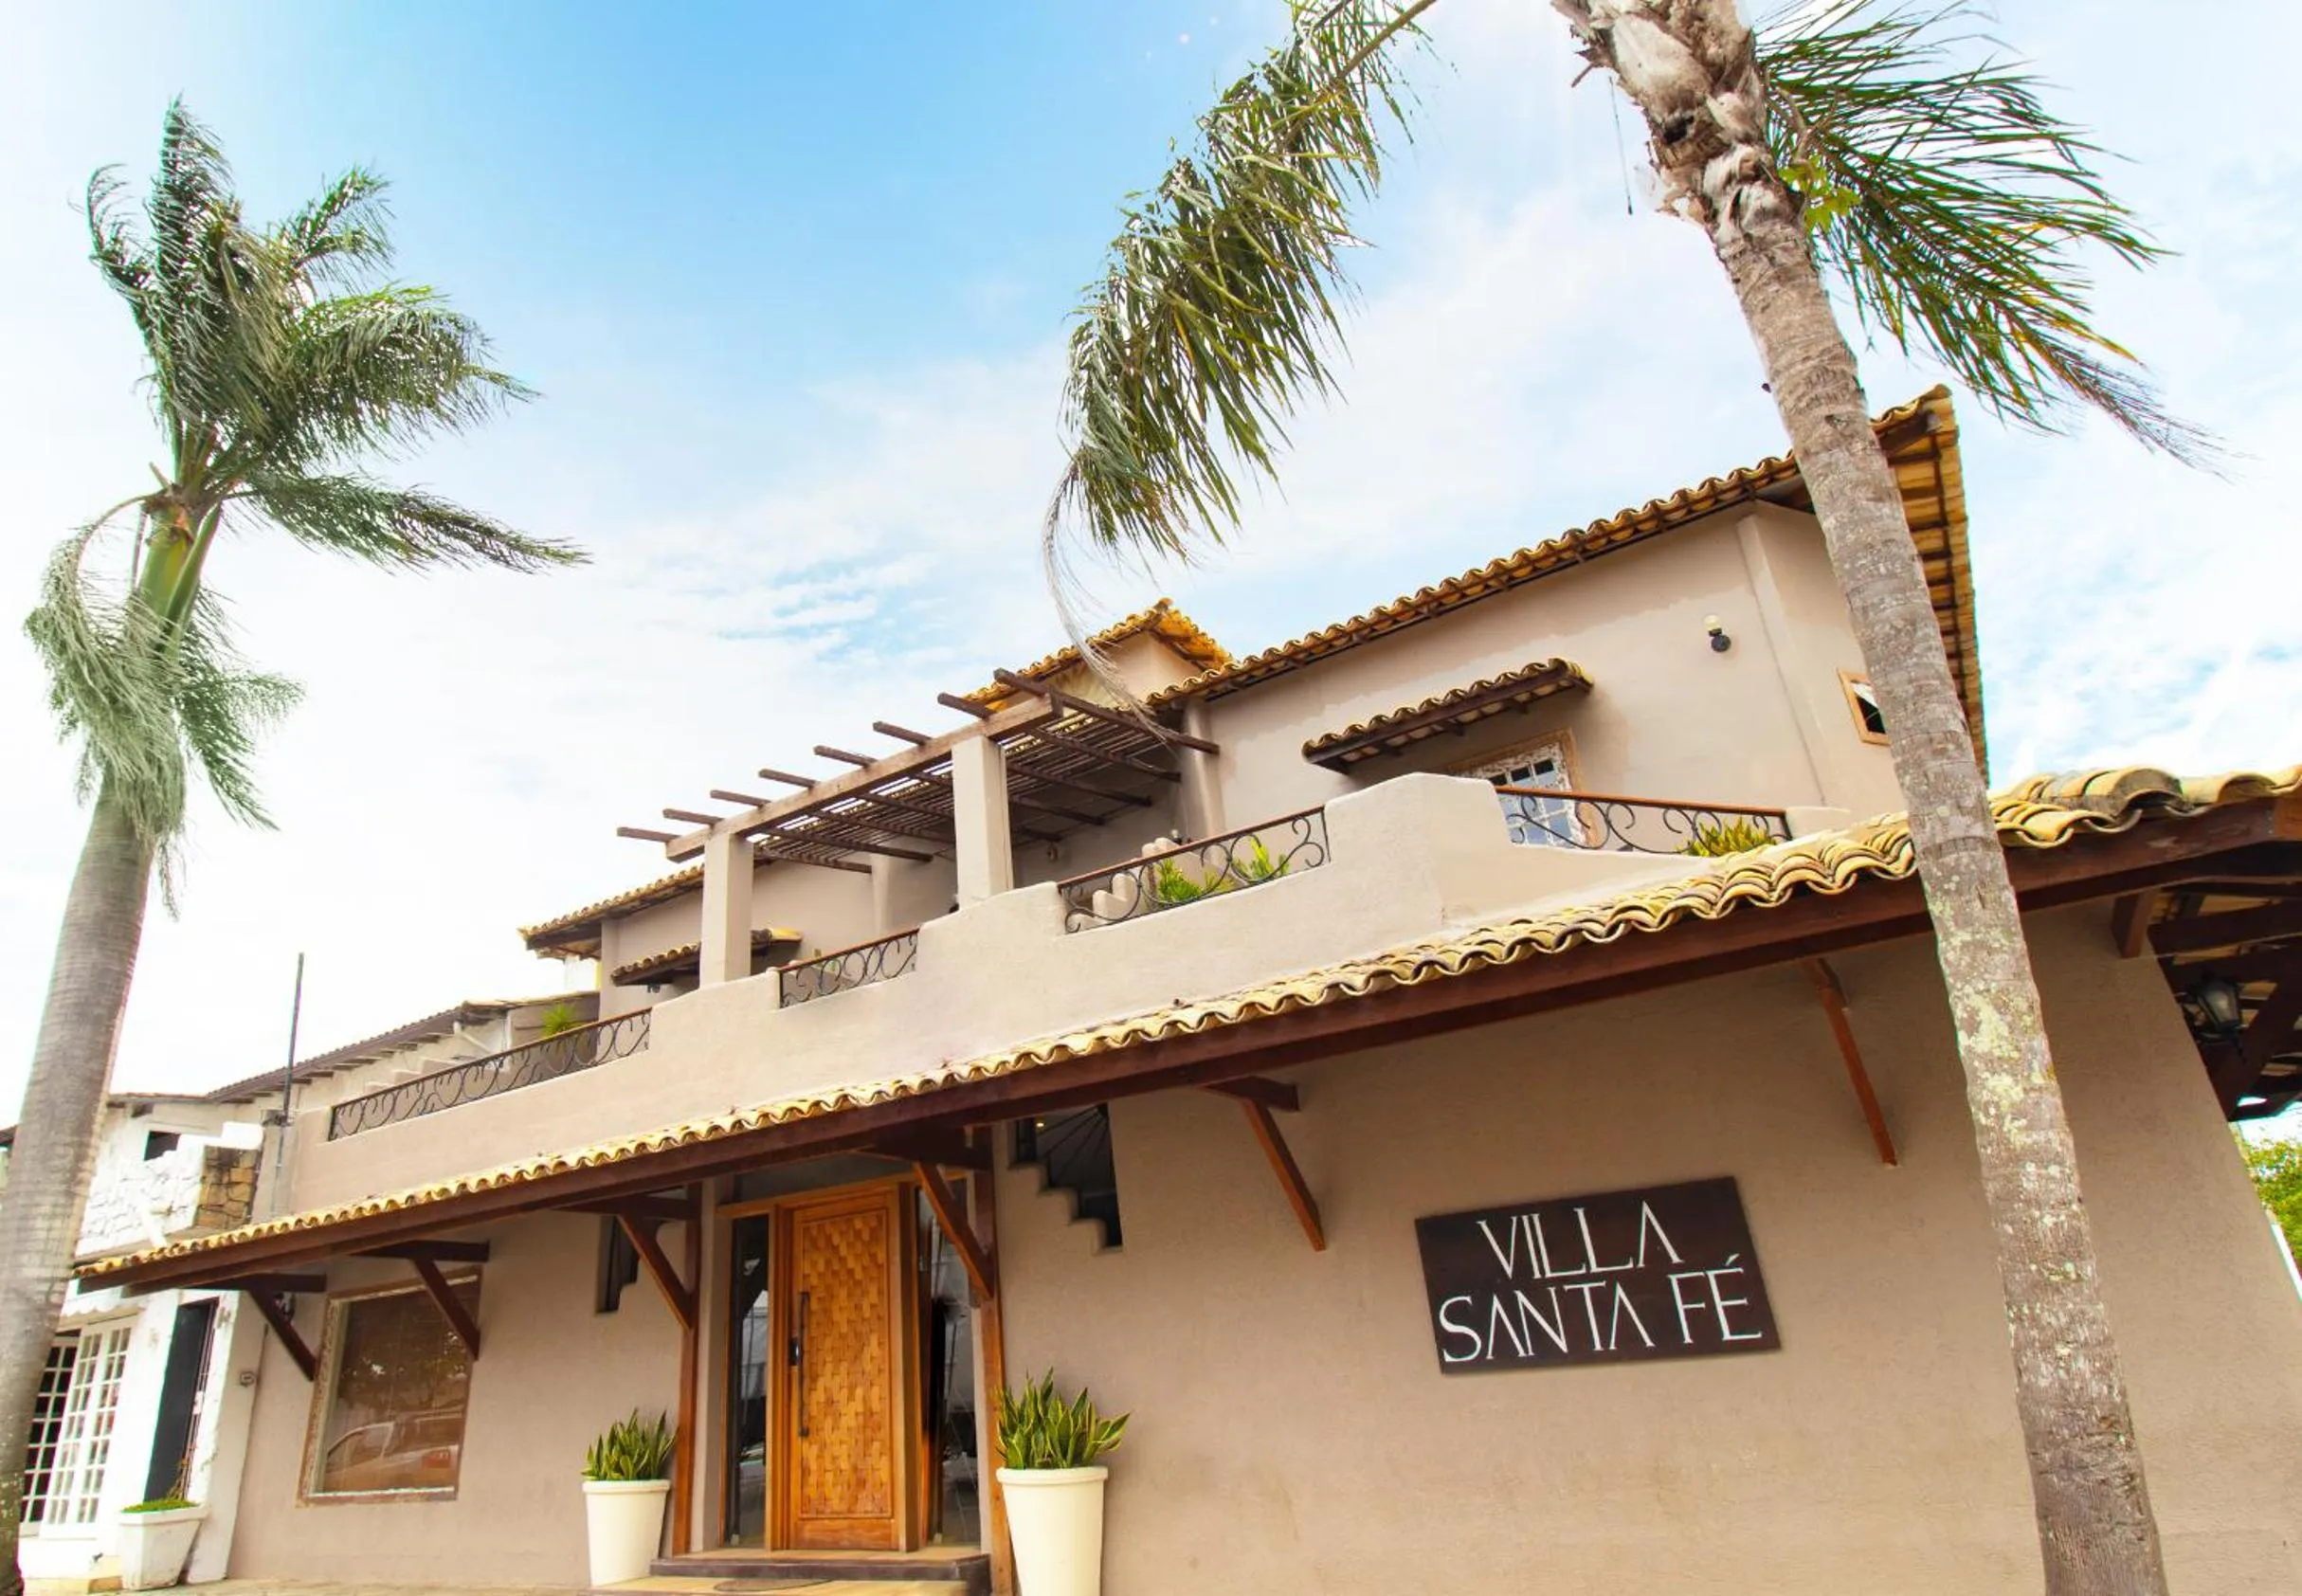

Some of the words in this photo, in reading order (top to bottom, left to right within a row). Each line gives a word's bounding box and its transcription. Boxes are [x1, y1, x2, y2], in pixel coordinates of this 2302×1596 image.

[1477, 1200, 1685, 1279] VILLA
[1439, 1280, 1655, 1363] SANTA
[1667, 1253, 1763, 1344] FÉ
